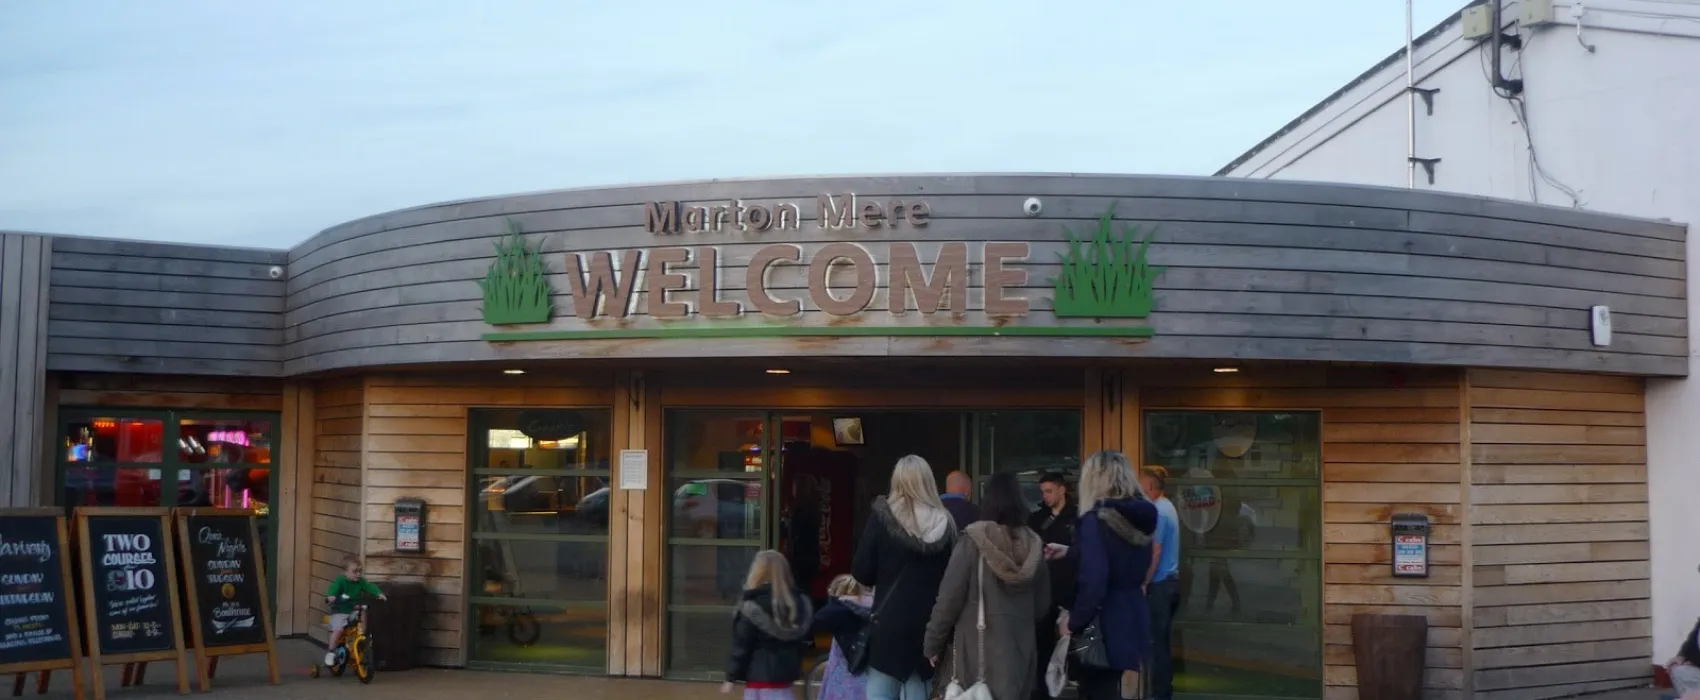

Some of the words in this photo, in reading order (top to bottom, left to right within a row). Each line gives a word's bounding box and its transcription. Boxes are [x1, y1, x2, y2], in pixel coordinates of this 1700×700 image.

[644, 198, 801, 236] Marton
[816, 192, 931, 229] Mere
[565, 242, 1031, 320] WELCOME
[0, 532, 50, 563] arvery
[103, 534, 151, 551] TWO
[103, 552, 156, 566] COURSES
[207, 560, 241, 570] SUNDAY
[1, 572, 44, 585] SUNDAY
